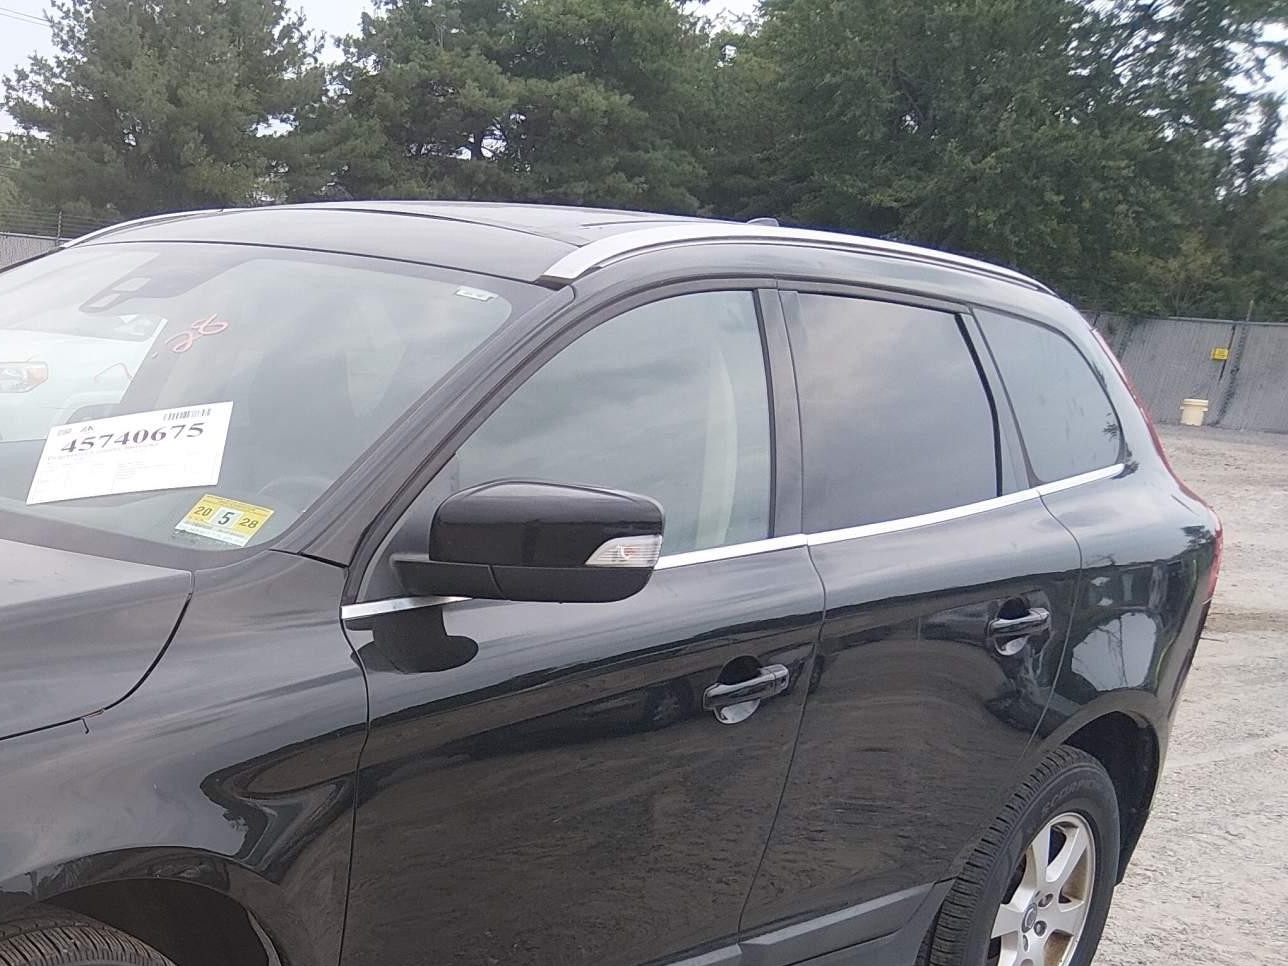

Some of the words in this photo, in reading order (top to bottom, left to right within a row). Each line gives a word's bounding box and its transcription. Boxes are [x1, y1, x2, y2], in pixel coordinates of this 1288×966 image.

[60, 421, 206, 453] 45740675
[193, 506, 213, 517] 20
[218, 511, 235, 525] 5
[239, 518, 259, 529] 28
